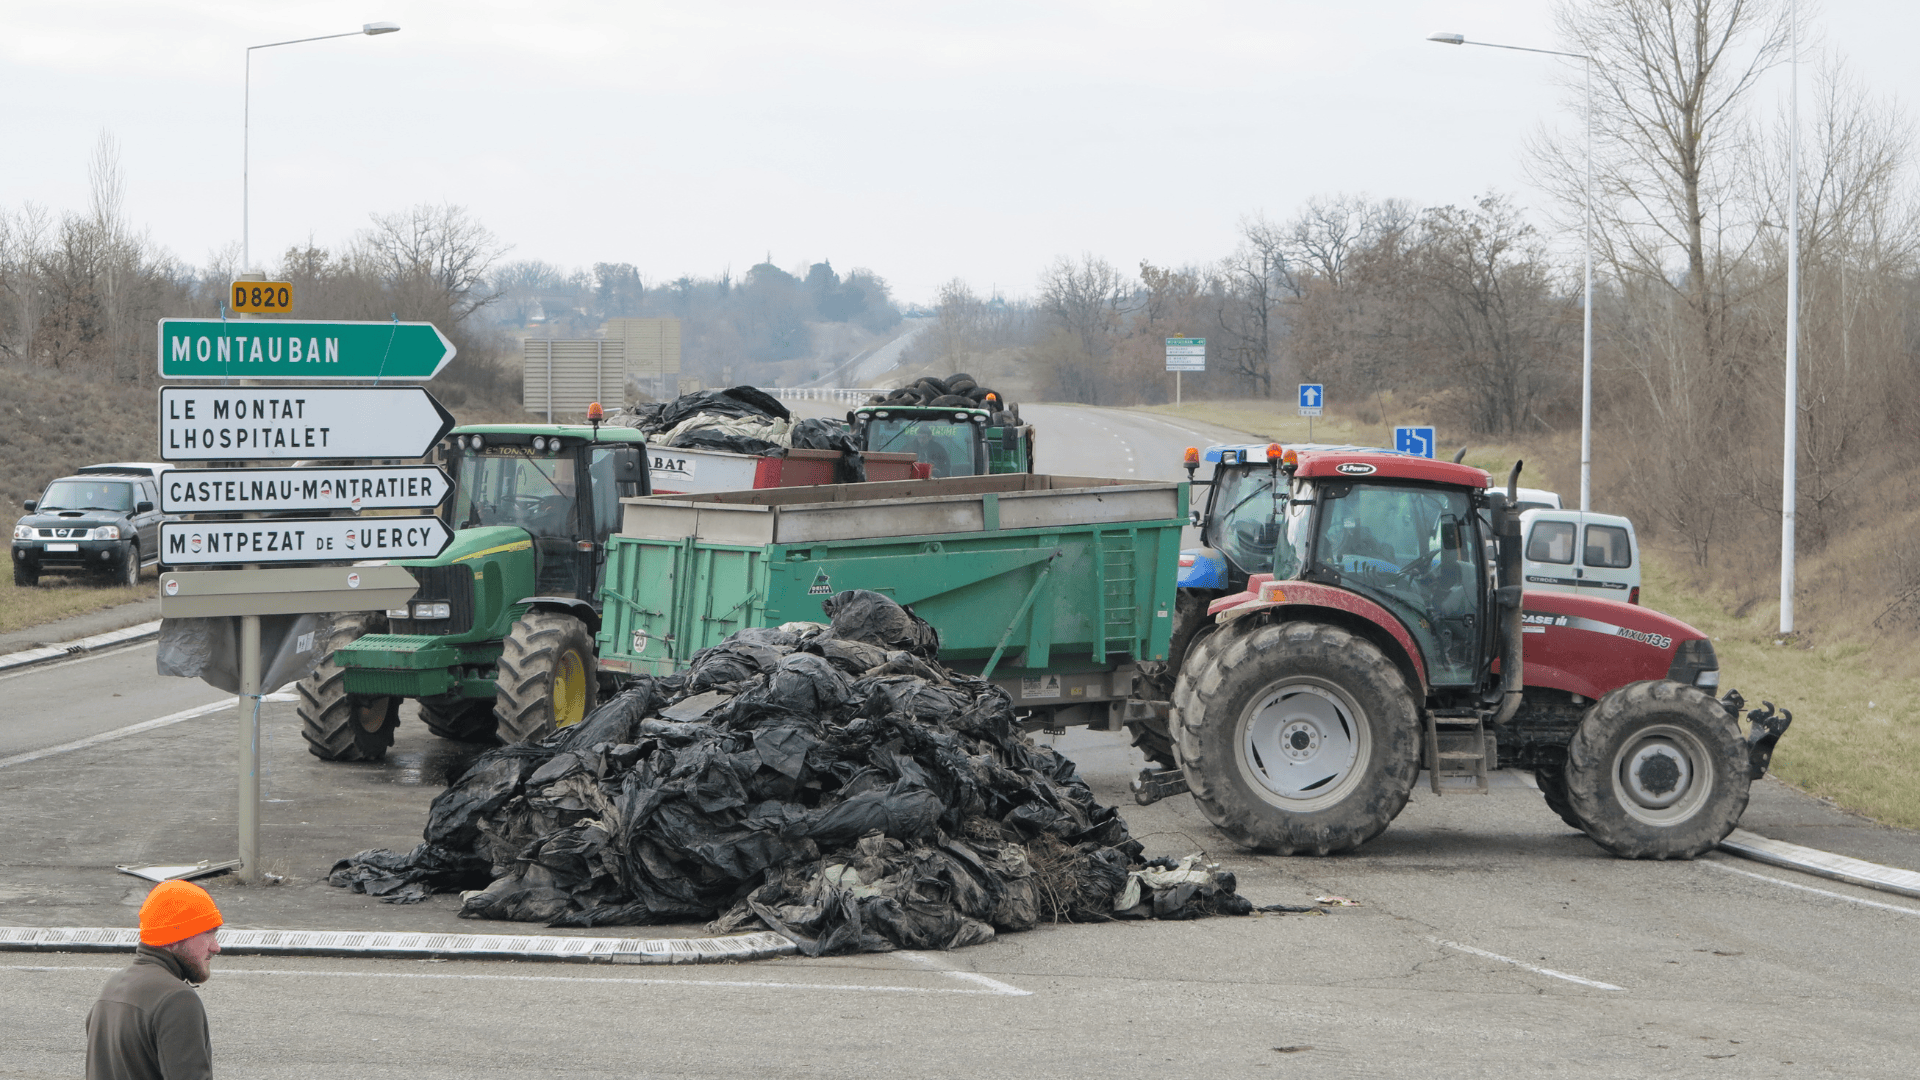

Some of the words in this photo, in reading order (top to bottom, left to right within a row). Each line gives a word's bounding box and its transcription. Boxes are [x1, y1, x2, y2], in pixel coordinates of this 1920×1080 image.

[171, 336, 339, 363] MONTAUBAN
[170, 400, 196, 420] LE
[213, 399, 306, 420] MONTAT
[170, 428, 330, 449] LHOSPITALET
[316, 537, 333, 551] DE
[1522, 614, 1554, 625] CASE
[1617, 627, 1672, 649] MXU135
